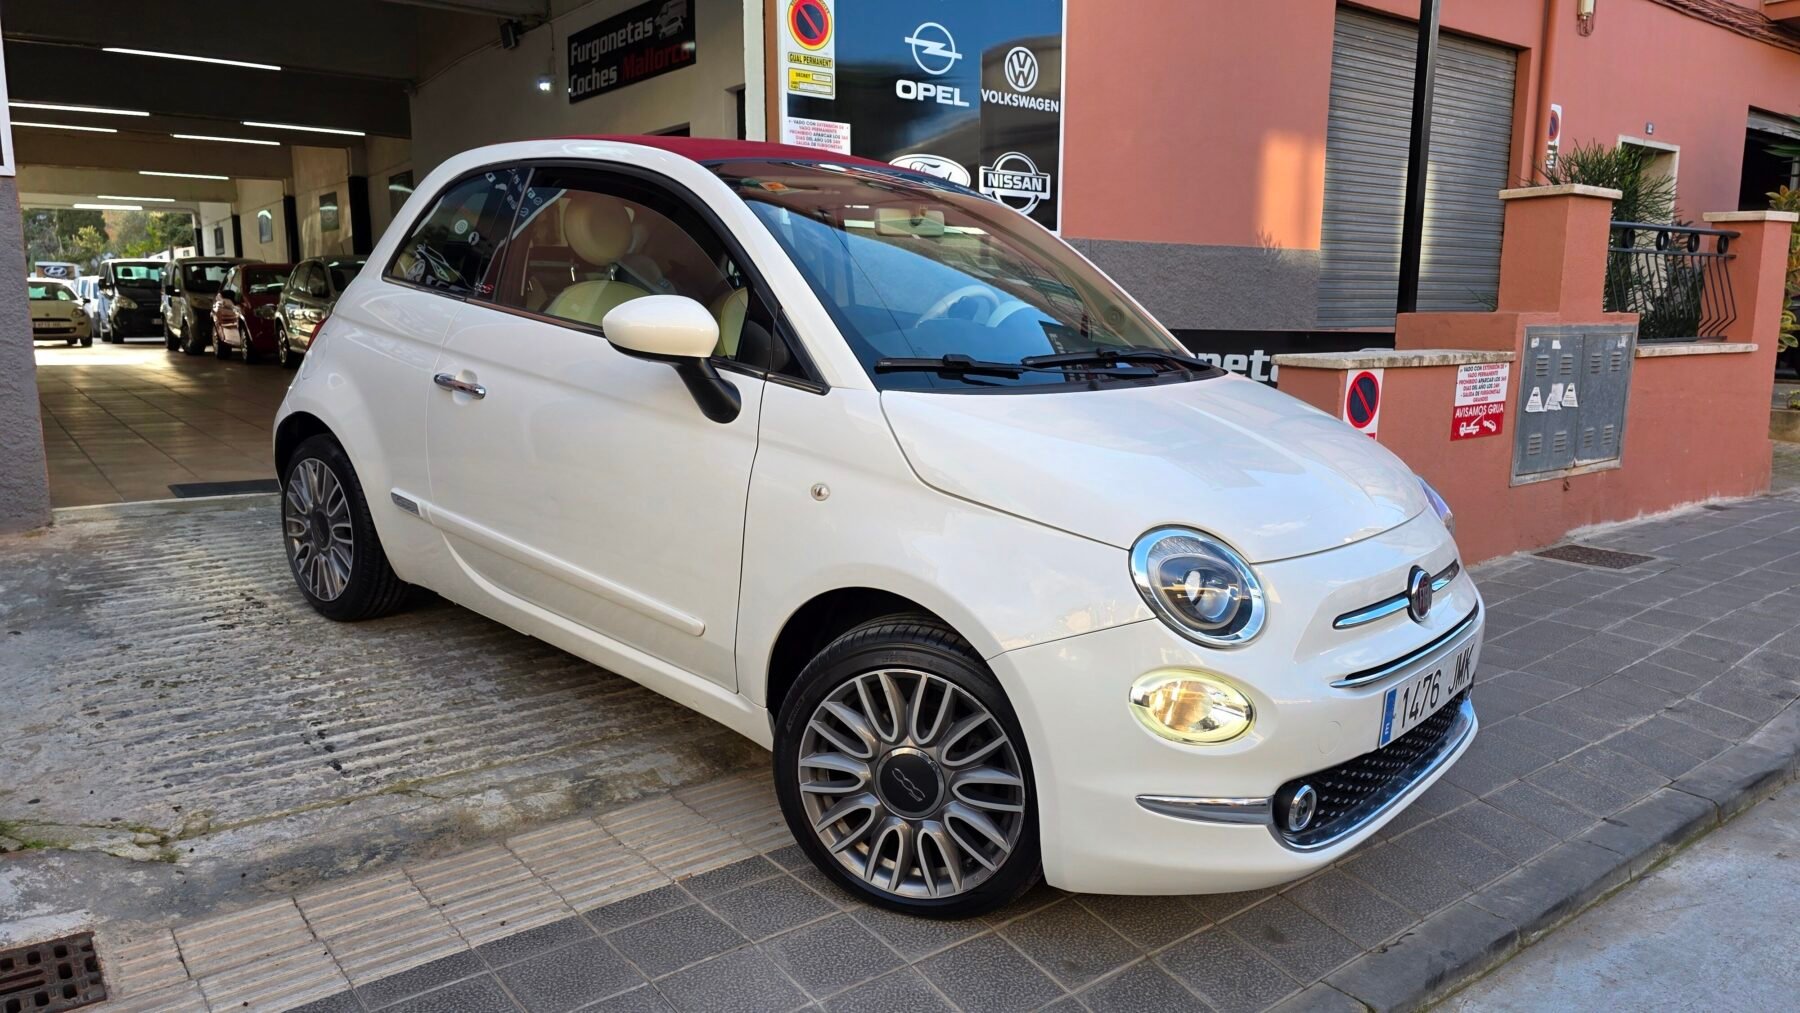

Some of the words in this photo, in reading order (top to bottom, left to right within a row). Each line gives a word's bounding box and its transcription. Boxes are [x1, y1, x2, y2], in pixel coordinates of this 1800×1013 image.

[570, 17, 653, 66] Furgonetas
[570, 65, 618, 97] Coches
[621, 43, 691, 81] Mallorca
[803, 55, 832, 67] PERMANENT
[896, 79, 970, 107] OPEL
[981, 88, 1060, 113] VOLKSWAGEN
[988, 173, 1043, 192] NISSAN
[1455, 404, 1487, 418] AVISAMOS
[1488, 402, 1504, 414] GRUA
[1402, 669, 1442, 729] 1476
[1448, 643, 1475, 695] JMK
